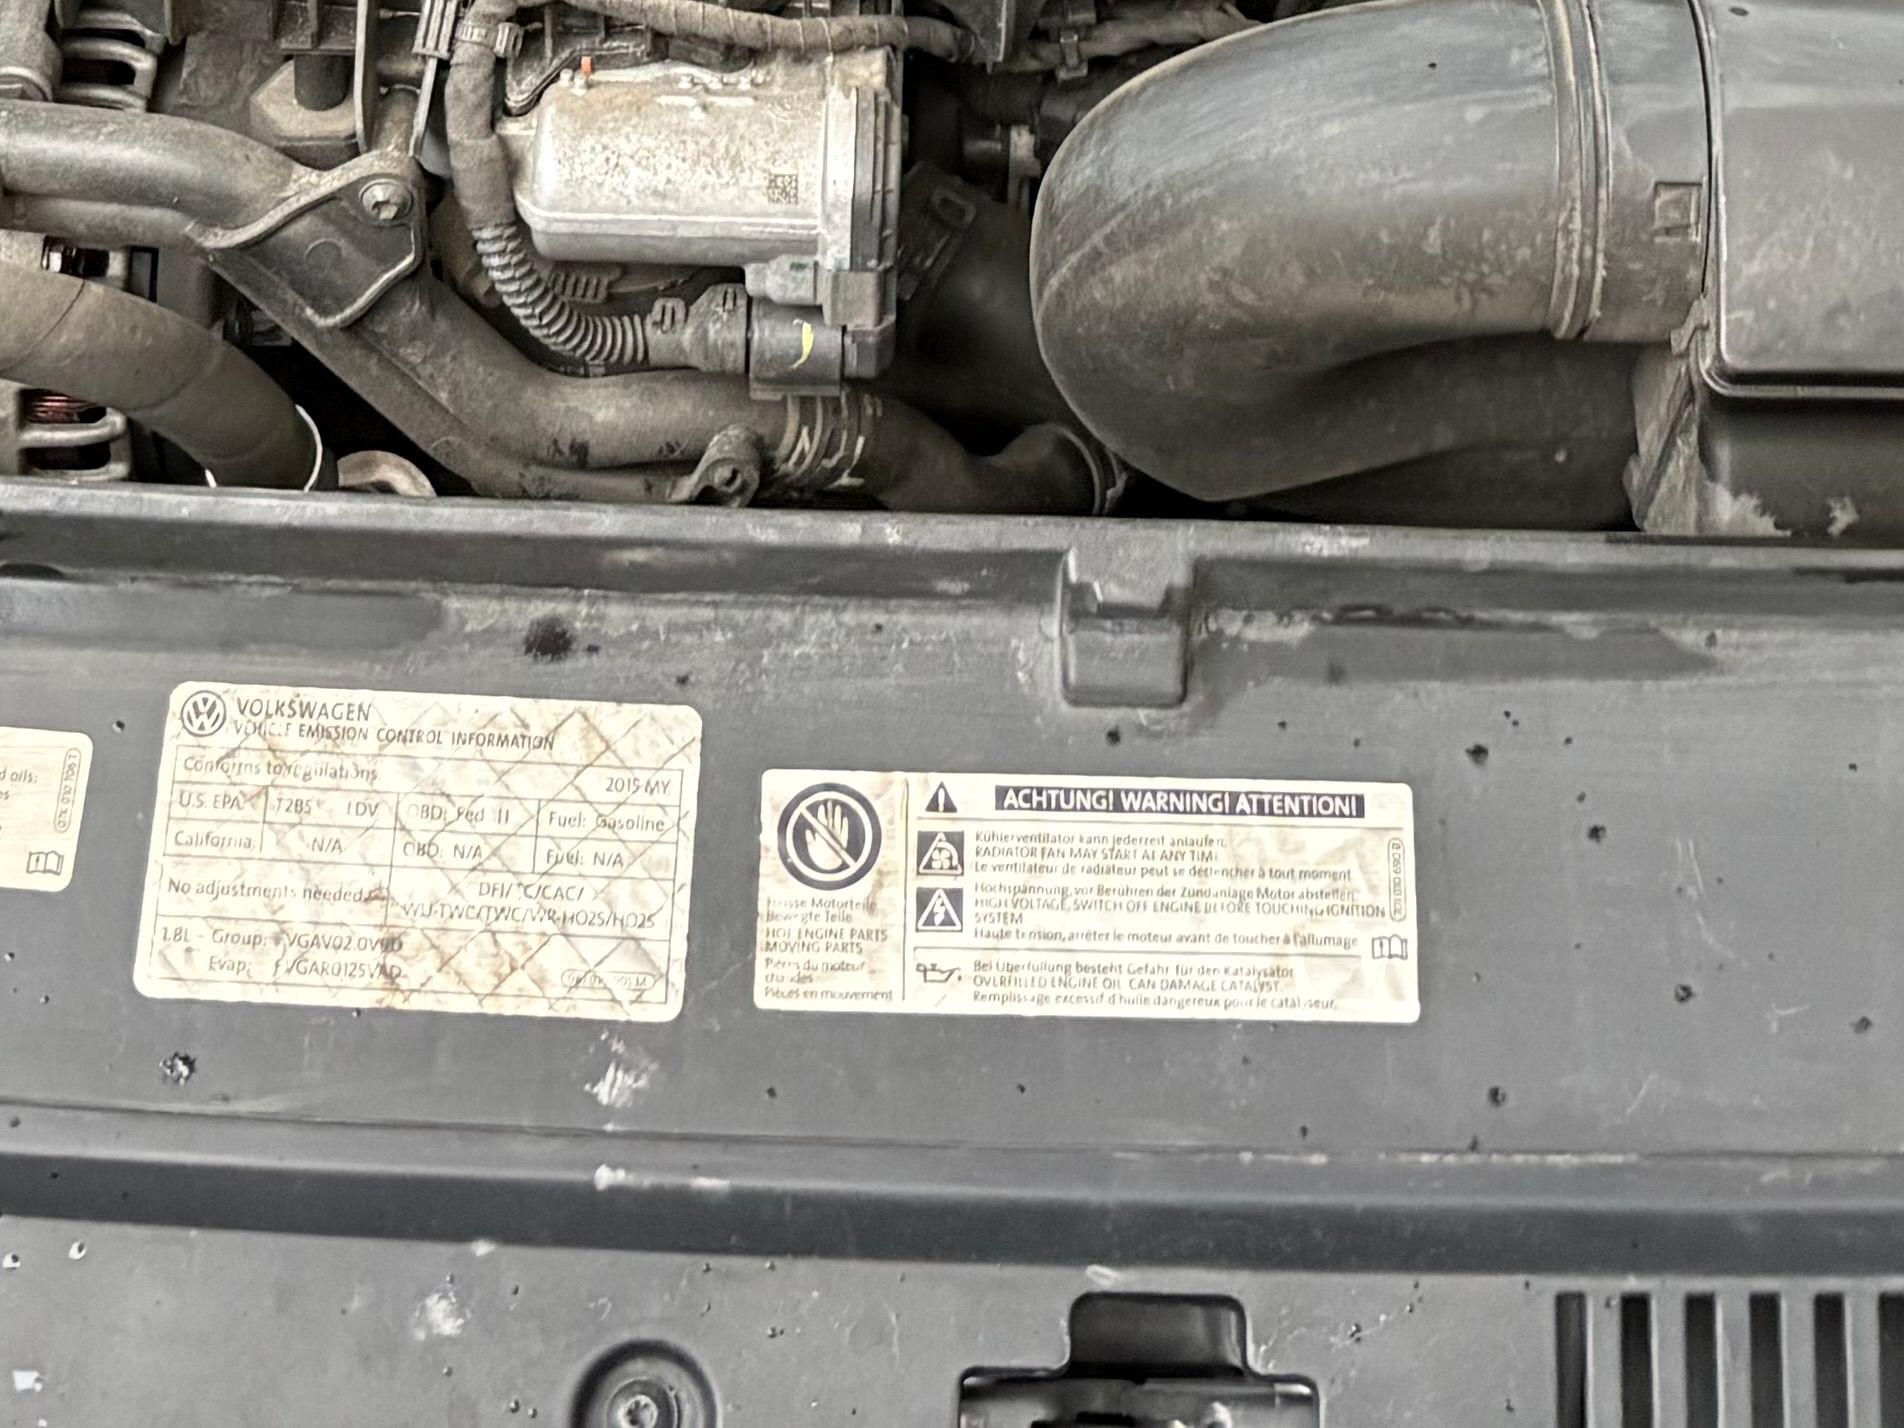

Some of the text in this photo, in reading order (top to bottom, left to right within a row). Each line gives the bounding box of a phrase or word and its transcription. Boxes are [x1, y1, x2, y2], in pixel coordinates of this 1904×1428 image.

[236, 697, 372, 722] VOLKSWAGEN
[298, 723, 556, 751] EMISSION CONTROL INFORMATION
[182, 756, 261, 774] Conforms
[605, 777, 671, 795] 2015 MY
[178, 793, 208, 809] U.S.
[1003, 787, 1358, 817] ACHTUNG! WARNING! ATTENTION!
[548, 811, 666, 832] Fuel: Gasoline
[310, 836, 344, 854] N/A
[453, 844, 483, 860] N/A
[974, 845, 1186, 862] RADIATOR FAN MAY START AT ANY
[546, 849, 624, 868] Fuel: N/A
[1080, 863, 1137, 877] radiateur
[1140, 865, 1169, 881] peut
[1268, 868, 1296, 880] tout
[1298, 868, 1352, 882] moment
[166, 877, 192, 893] No
[1255, 887, 1296, 900] Motor
[1073, 898, 1123, 912] SWITCH
[1125, 899, 1148, 913] OFF
[1152, 900, 1202, 914] ENGINE
[1326, 904, 1386, 918] IGNITION
[974, 912, 1024, 925] SYSTEM
[766, 927, 889, 943] HOT ENGINE PARTS
[1126, 929, 1173, 943] moteur
[1176, 930, 1211, 943] avant
[1214, 931, 1230, 944] de
[1232, 931, 1281, 945] toucher
[1292, 932, 1359, 950] l'allumage
[765, 940, 864, 955] MOVING PARTS
[802, 959, 865, 973] du moteur
[1074, 961, 1194, 976] besteht Gefahr für
[972, 974, 1216, 992] OVERFILLED ENGINE OIL CAN DAMAGE
[802, 990, 893, 1001] en mouvement
[1054, 991, 1220, 1011] excessif dangereux
